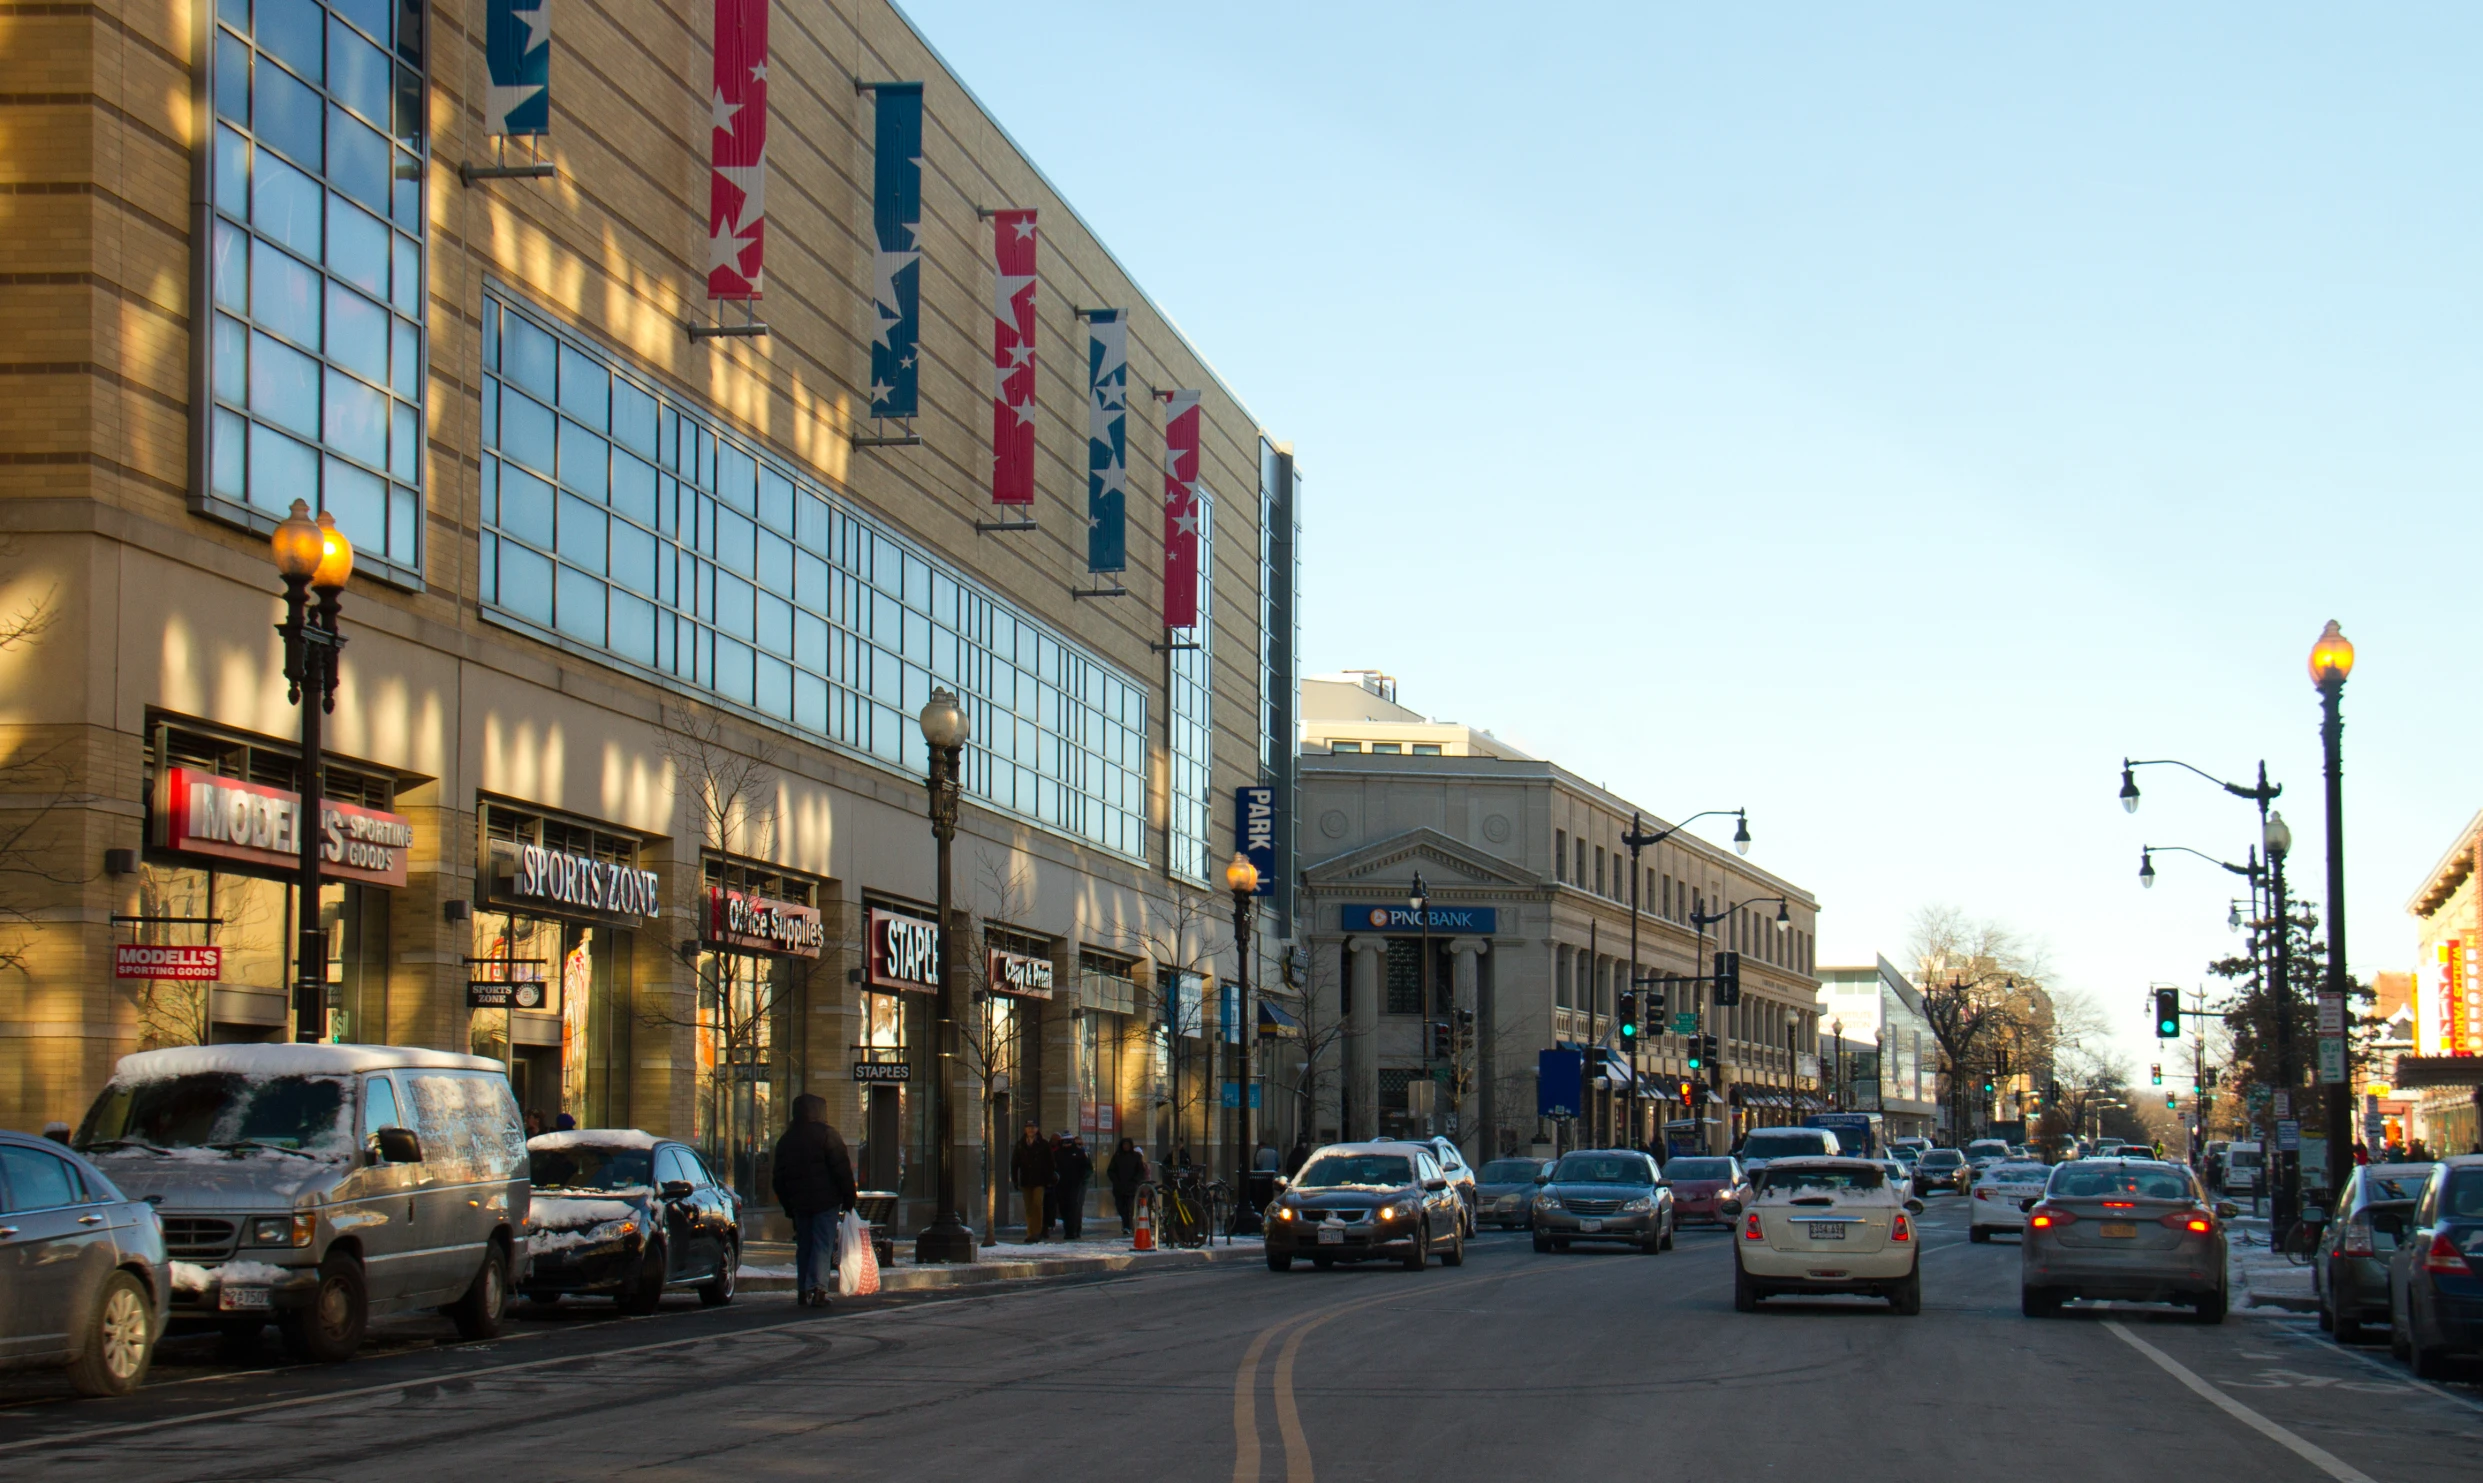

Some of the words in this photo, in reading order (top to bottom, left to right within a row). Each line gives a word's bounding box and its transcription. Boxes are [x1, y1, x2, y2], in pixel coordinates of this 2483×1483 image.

[190, 783, 343, 862] MODEL'S
[350, 815, 413, 848] SPORTING
[1248, 789, 1271, 850] PARK
[350, 843, 393, 871] GOODS
[523, 844, 601, 909] SPORTS
[607, 863, 659, 918] ZONE
[729, 898, 767, 938] Office
[771, 907, 824, 950] Supplies
[1390, 910, 1424, 925] PNC
[1429, 911, 1473, 927] BANK
[119, 948, 217, 966] MODELL'S
[887, 919, 939, 985] STAPLE
[119, 966, 175, 975] SPORTING
[177, 967, 217, 976] GOODS
[1005, 957, 1025, 990] Copy
[1026, 962, 1032, 985] &
[1033, 963, 1053, 989] Print
[2452, 946, 2463, 998] WELLS
[472, 985, 512, 994] SPORTS
[479, 994, 506, 1003] ZONE
[2454, 1001, 2466, 1051] FARGO
[855, 1066, 909, 1079] STAPLES
